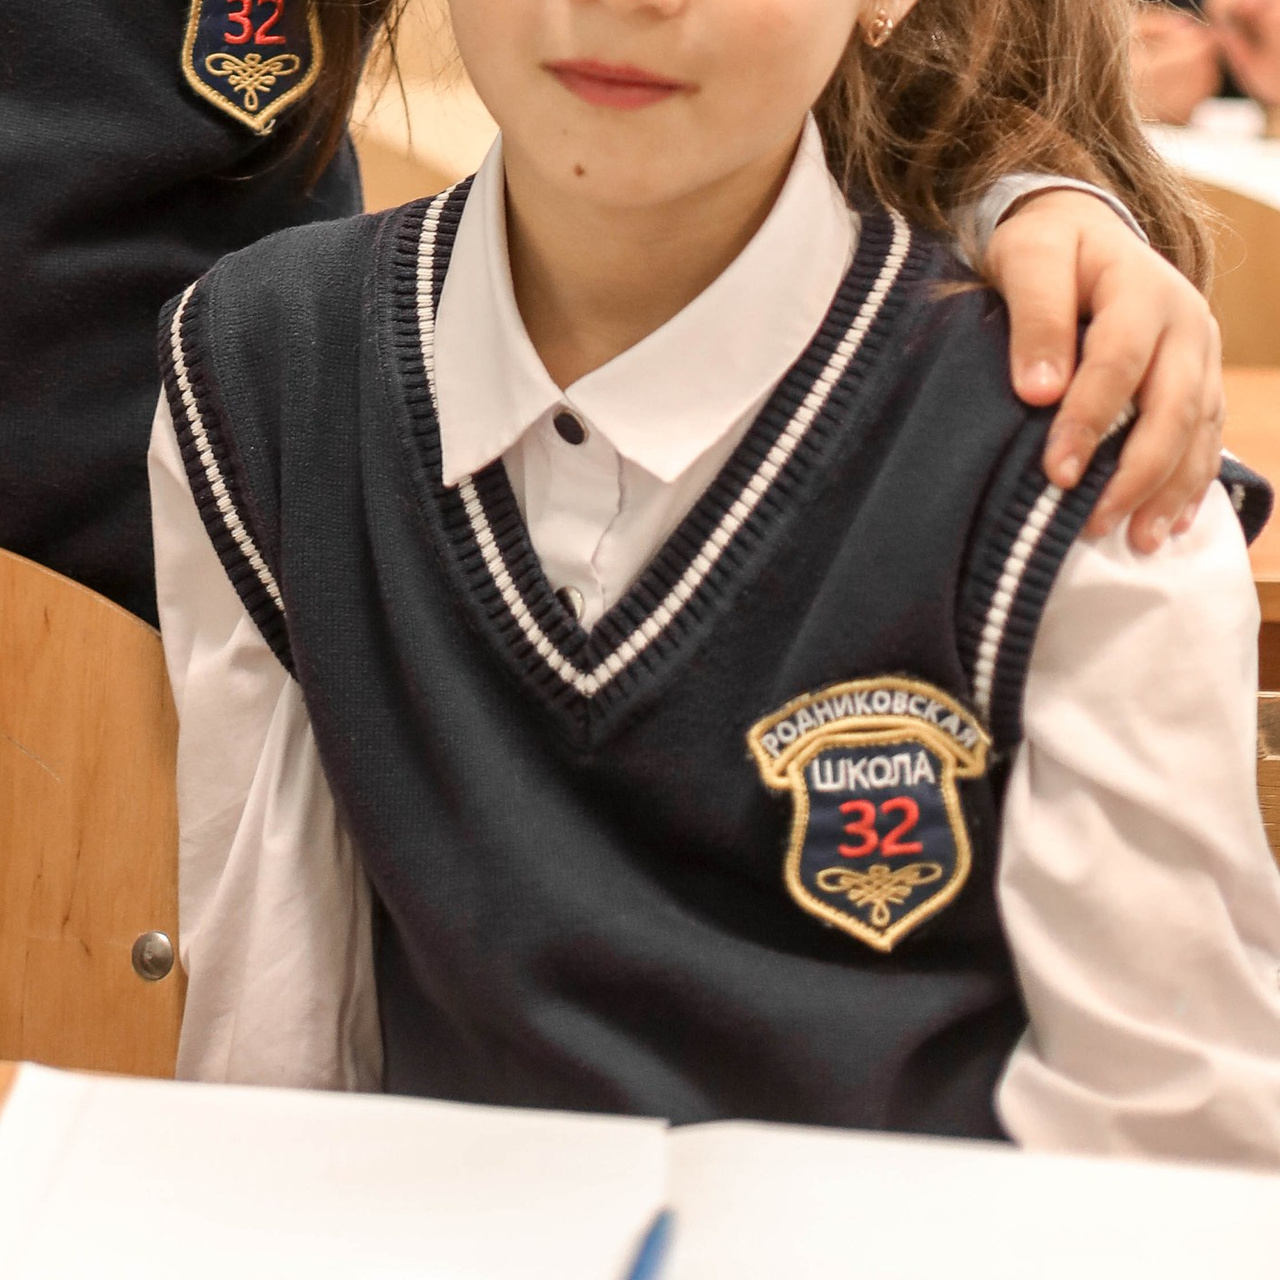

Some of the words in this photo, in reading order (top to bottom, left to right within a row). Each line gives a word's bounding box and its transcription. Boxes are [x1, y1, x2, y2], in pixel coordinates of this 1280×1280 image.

[759, 690, 979, 759] РОДНИКОВСКАЯ
[810, 749, 936, 791] ШКОЛА
[836, 795, 924, 859] 32
